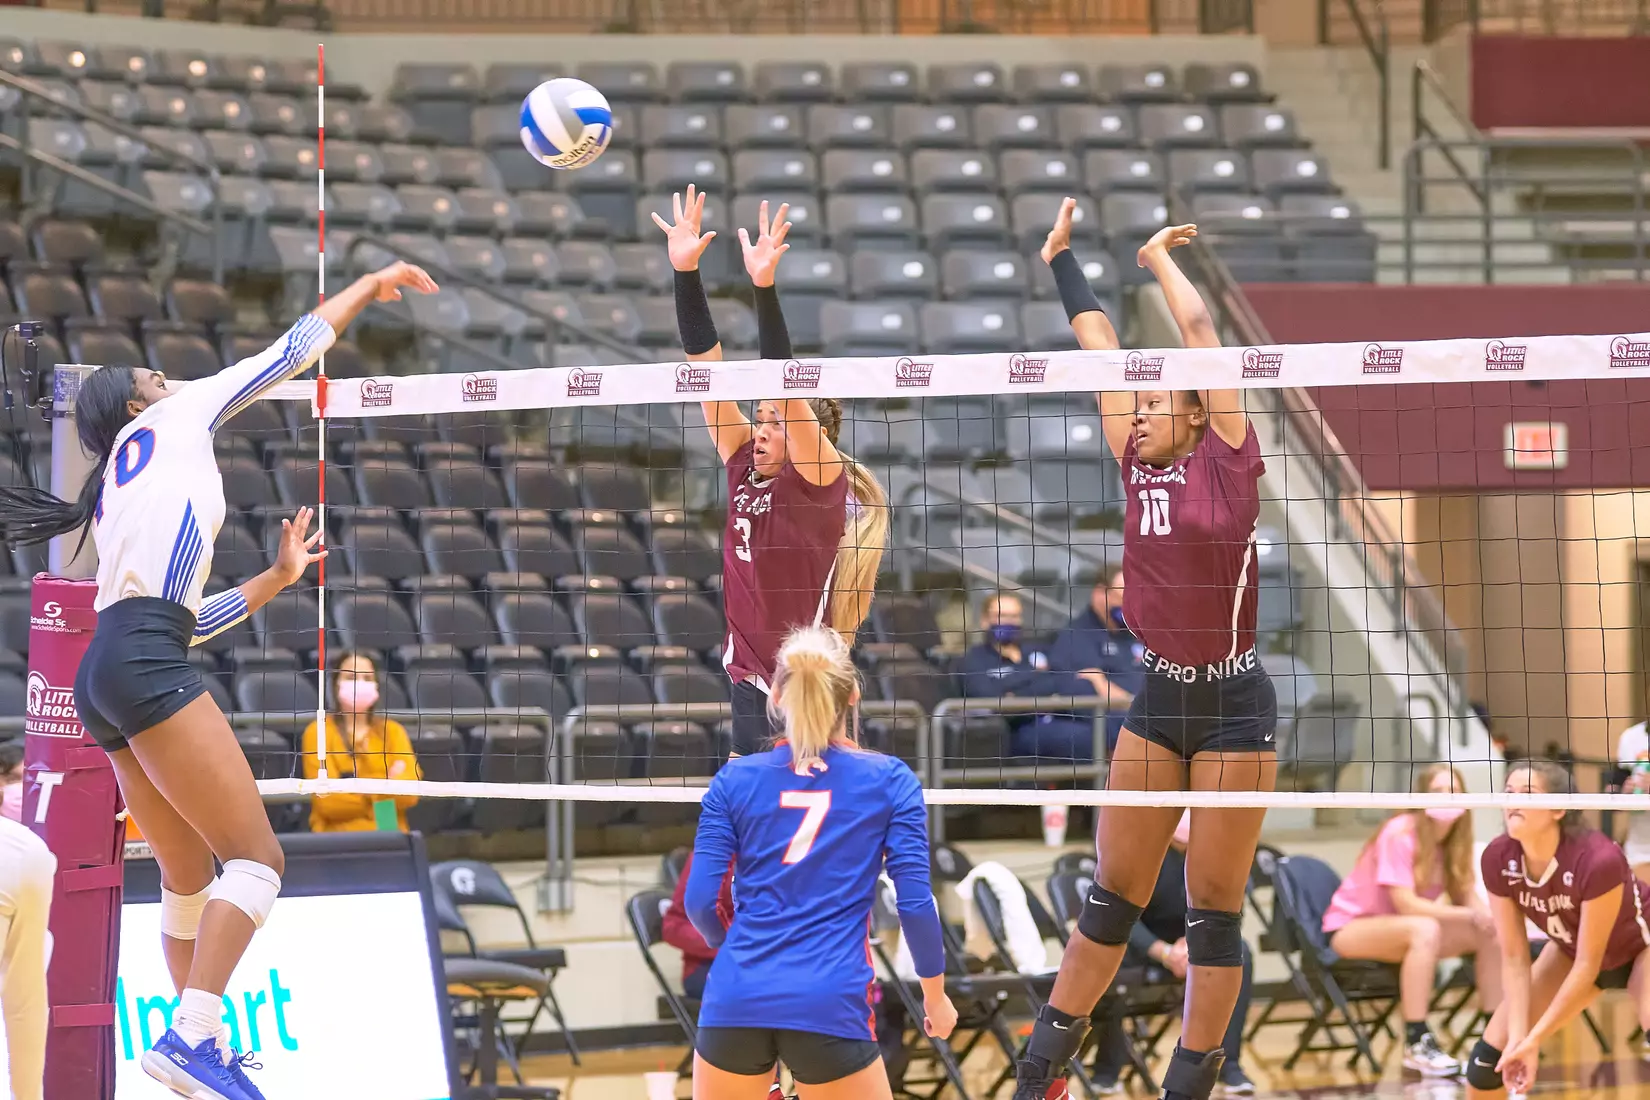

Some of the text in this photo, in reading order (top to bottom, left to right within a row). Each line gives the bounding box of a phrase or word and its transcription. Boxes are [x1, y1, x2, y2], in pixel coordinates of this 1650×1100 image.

[552, 136, 596, 165] molten
[1380, 350, 1402, 358] LITTLE
[1627, 350, 1650, 358] ROCK
[1628, 343, 1650, 351] LITTLE
[1025, 360, 1047, 368] LITTLE
[1259, 354, 1282, 362] LITTLE
[1611, 359, 1649, 367] VOLLEYBALL
[1010, 375, 1043, 383] VOLLEYBALL
[1243, 370, 1278, 378] VOLLEYBALL
[464, 394, 495, 402] VOLLEYBALL
[1138, 488, 1172, 536] 10
[733, 517, 752, 563] 3
[1154, 656, 1197, 684] PRO
[1207, 651, 1256, 682] NIKE
[45, 690, 75, 706] LITT
[25, 719, 79, 736] OLLEYBALL
[34, 770, 65, 824] T
[779, 789, 833, 865] 7
[1546, 914, 1573, 944] 4
[116, 968, 299, 1061] lmart
